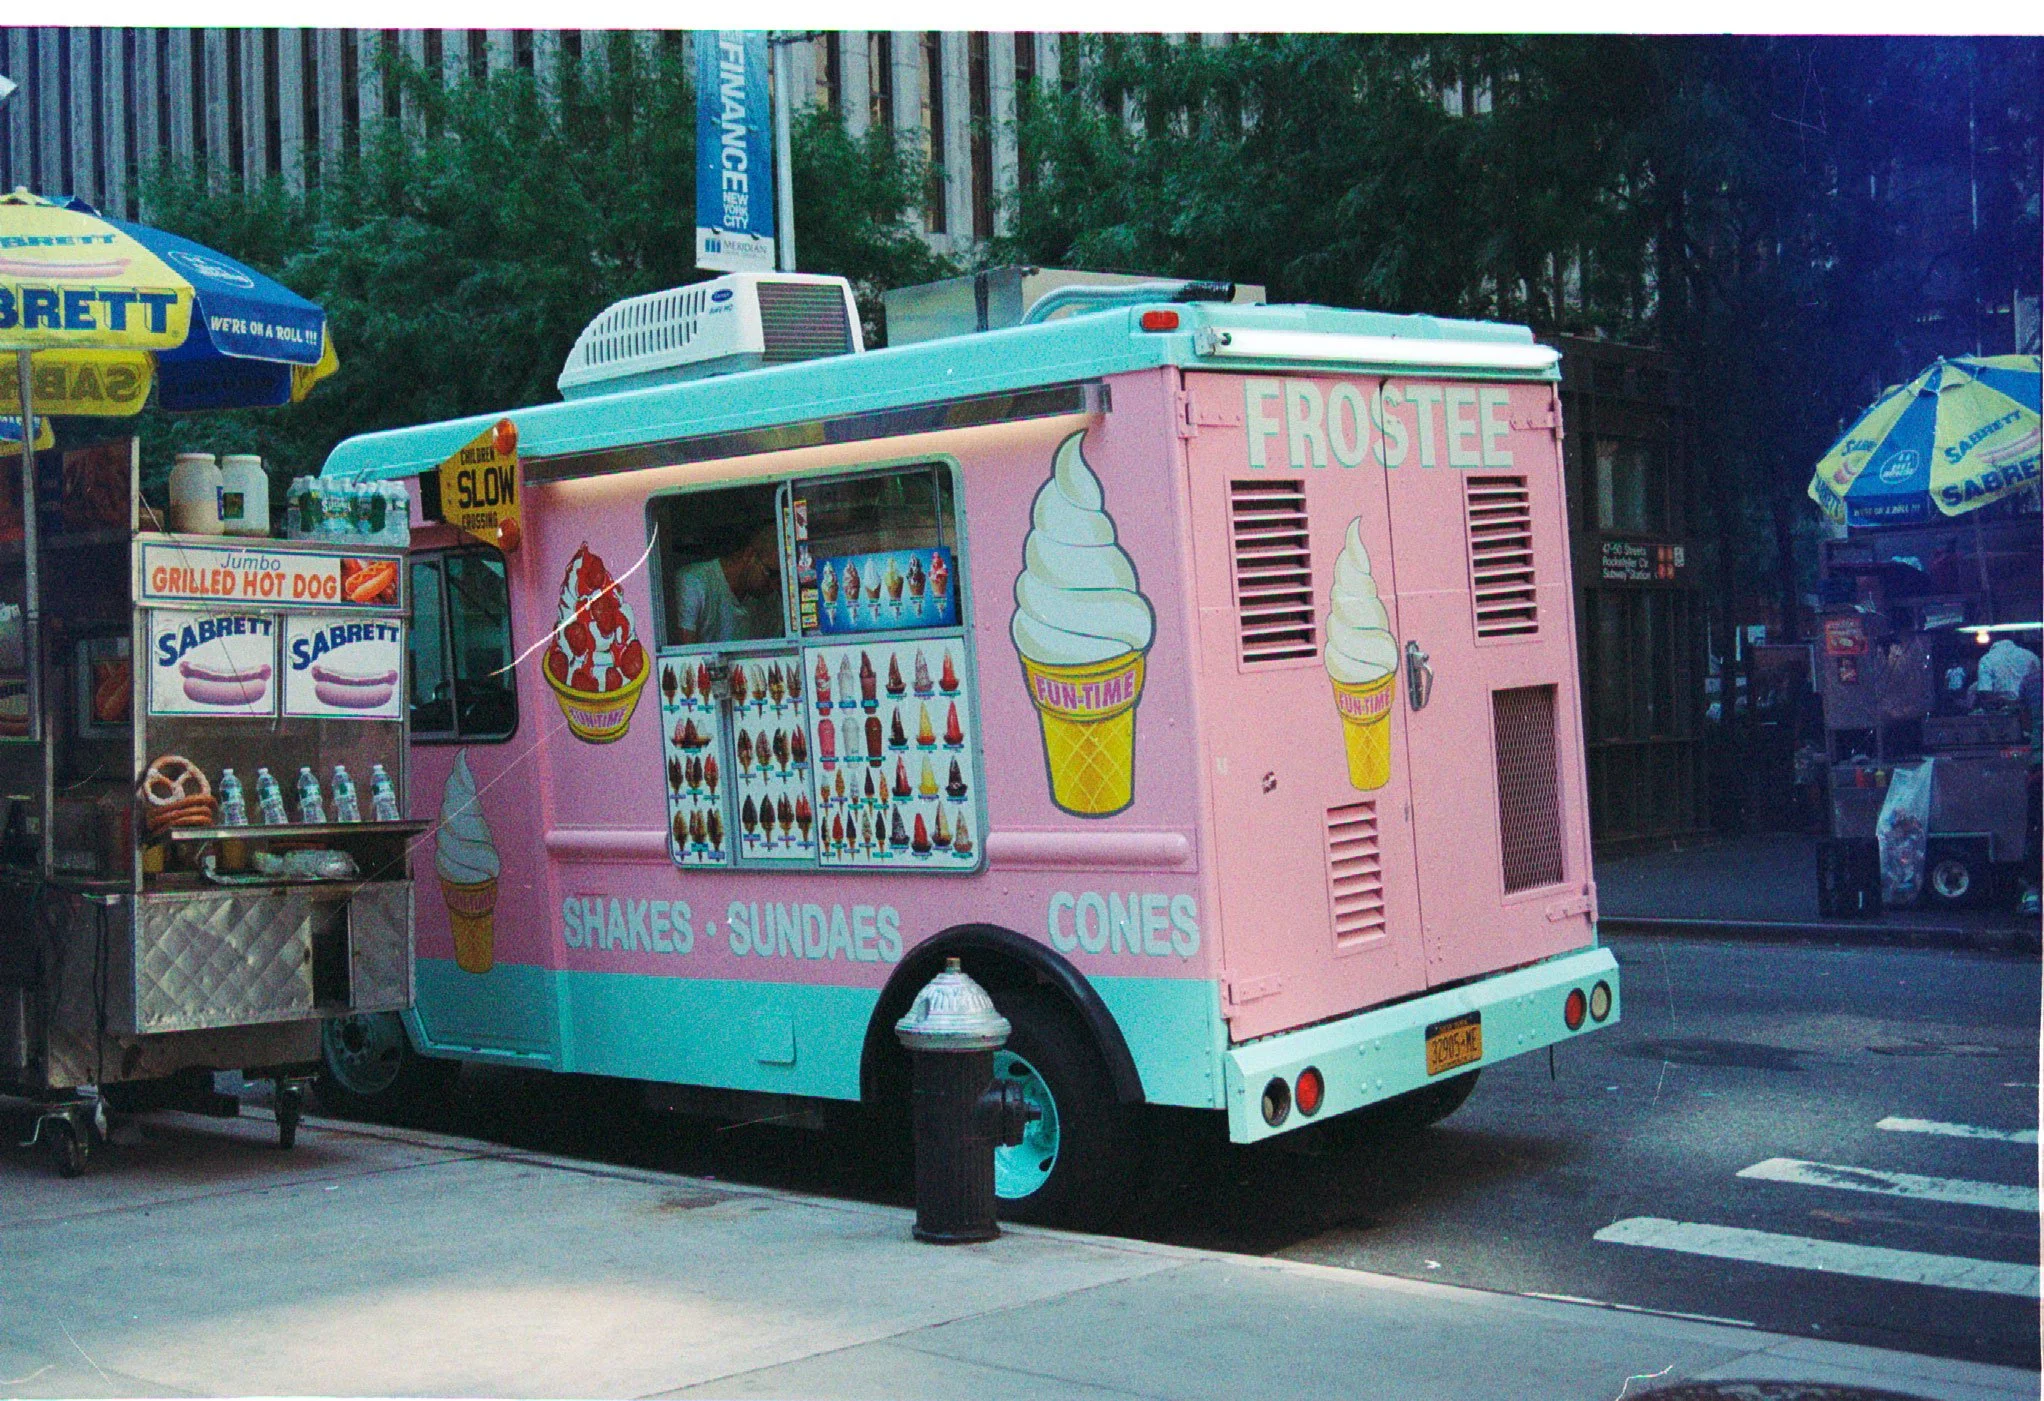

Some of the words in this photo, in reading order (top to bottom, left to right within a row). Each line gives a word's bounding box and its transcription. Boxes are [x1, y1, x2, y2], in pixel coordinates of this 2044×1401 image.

[719, 40, 749, 193] FINANCE
[723, 191, 749, 206] NEW
[724, 215, 748, 229] CITY
[210, 316, 247, 334] WE'RE
[250, 321, 264, 336] ON
[265, 324, 273, 338] A
[276, 326, 303, 343] ROLL
[1243, 378, 1514, 469] FROSTEE
[457, 465, 515, 508] SLOW
[1941, 454, 2042, 507] SABRE
[152, 566, 237, 596] GRILLED
[242, 570, 286, 598] HOT
[292, 573, 337, 599] DOG
[220, 553, 281, 571] Jumbo
[157, 616, 272, 667] SABRETT
[290, 623, 400, 671] SABRETT
[1035, 671, 1136, 711] FUN-TIME
[562, 896, 695, 955] SHAKES
[727, 900, 904, 963] SUNDAES
[1048, 891, 1201, 957] CONES
